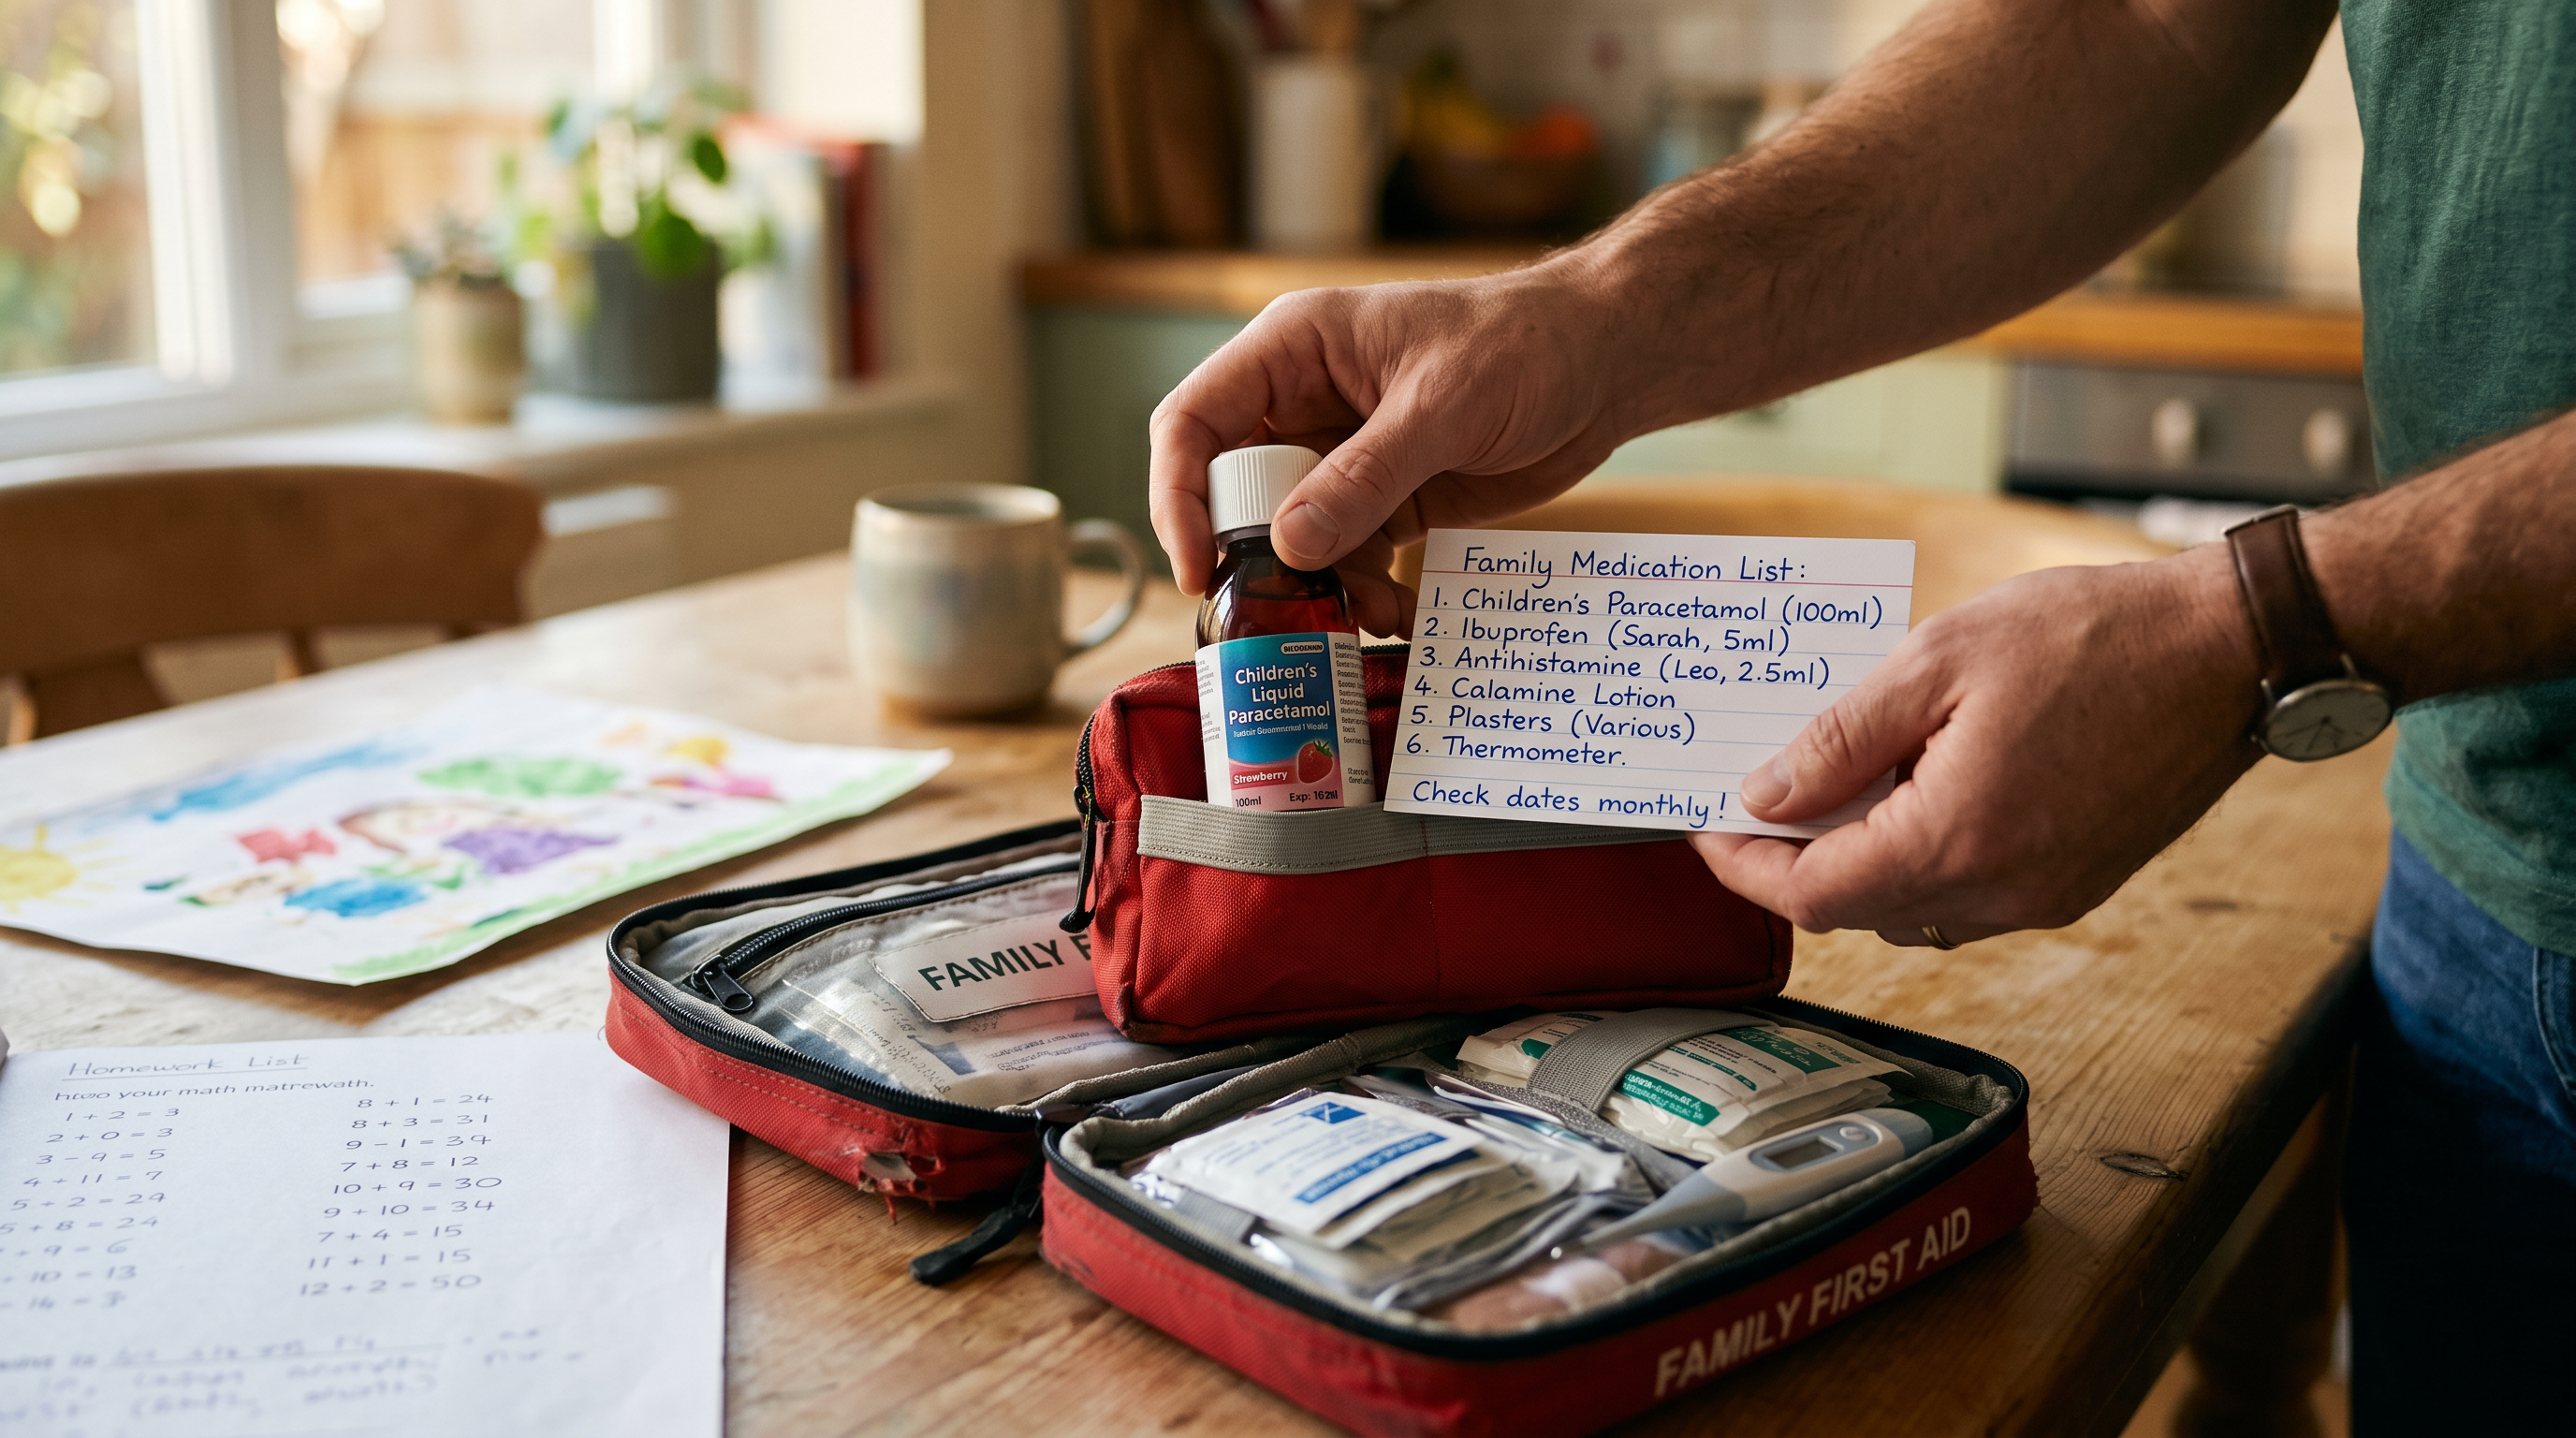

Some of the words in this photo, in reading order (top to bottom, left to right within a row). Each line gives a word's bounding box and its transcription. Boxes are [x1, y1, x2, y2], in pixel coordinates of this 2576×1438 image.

[1464, 547, 1551, 588] Family
[1571, 550, 1721, 580] Medication
[1740, 556, 1805, 583] List:
[1434, 587, 1447, 607] 1.
[1463, 588, 1589, 615] Children's
[1608, 591, 1765, 620] Paracetamol
[1783, 594, 1881, 629] (100ml)
[1424, 617, 1447, 636] 2.
[1462, 617, 1588, 653] Ibuprofen
[1608, 620, 1709, 653] (Sarah,
[1725, 626, 1789, 656] 5ml)
[1236, 662, 1317, 684] Children's
[1420, 646, 1442, 666] 3.
[1455, 647, 1641, 677] Antihistamine
[1660, 653, 1725, 684] (Leo,
[1738, 657, 1829, 690] 2.5ml)
[1252, 682, 1304, 704] Liquid
[1414, 675, 1437, 696] 4.
[1452, 678, 1575, 703] Calamine
[1594, 683, 1675, 708] Lotion
[1229, 701, 1330, 725] Paracetamol
[1411, 706, 1432, 724] 5.
[1449, 705, 1551, 732] Plasters
[1572, 710, 1694, 745] (Various)
[1407, 733, 1428, 754] 6.
[1442, 736, 1625, 765] Thermometer.
[1236, 796, 1261, 807] 100ml
[1290, 793, 1310, 802] Exp:
[1413, 781, 1489, 805] Check
[1507, 785, 1579, 811] dates
[1600, 792, 1725, 828] monthly!
[918, 940, 1064, 990] FAMILY
[68, 1059, 224, 1076] Homework
[249, 1054, 309, 1067] List
[118, 1088, 173, 1100] your
[179, 1085, 236, 1096] math
[358, 1099, 373, 1108] 8
[459, 1094, 493, 1103] 24
[66, 1112, 72, 1121] 1
[109, 1111, 125, 1120] 2
[352, 1120, 367, 1128] 8
[403, 1118, 417, 1126] 3
[457, 1115, 488, 1123] 31
[157, 1128, 173, 1137] 3
[346, 1140, 361, 1150] 9
[401, 1138, 405, 1147] 1
[36, 1155, 53, 1164] 3
[91, 1152, 107, 1162] 9
[148, 1149, 166, 1160] 5
[341, 1162, 357, 1172] 7
[392, 1160, 408, 1168] 8
[451, 1156, 479, 1167] 12
[23, 1177, 41, 1186] 4
[81, 1174, 103, 1183] 11
[146, 1171, 163, 1180] 7
[334, 1184, 360, 1194] 10
[399, 1181, 415, 1191] 9
[455, 1178, 502, 1189] 30
[10, 1199, 31, 1211] 5
[67, 1197, 85, 1208] 2
[324, 1208, 341, 1218] 9
[382, 1205, 409, 1215] 10
[451, 1200, 495, 1212] 34
[55, 1221, 74, 1230] 8
[116, 1216, 158, 1229] 24
[318, 1231, 334, 1243] 7
[373, 1228, 390, 1240] 4
[434, 1224, 463, 1238] 15
[44, 1245, 62, 1255] 9
[107, 1238, 134, 1254] 6
[349, 1257, 364, 1266] +
[439, 1249, 471, 1263] 15
[107, 1265, 137, 1280] 13
[369, 1280, 387, 1293] 2
[432, 1274, 482, 1290] 50
[1655, 1293, 1803, 1398] FAMILY
[1808, 1238, 1911, 1327] FIRST
[1917, 1207, 1970, 1272] AID
